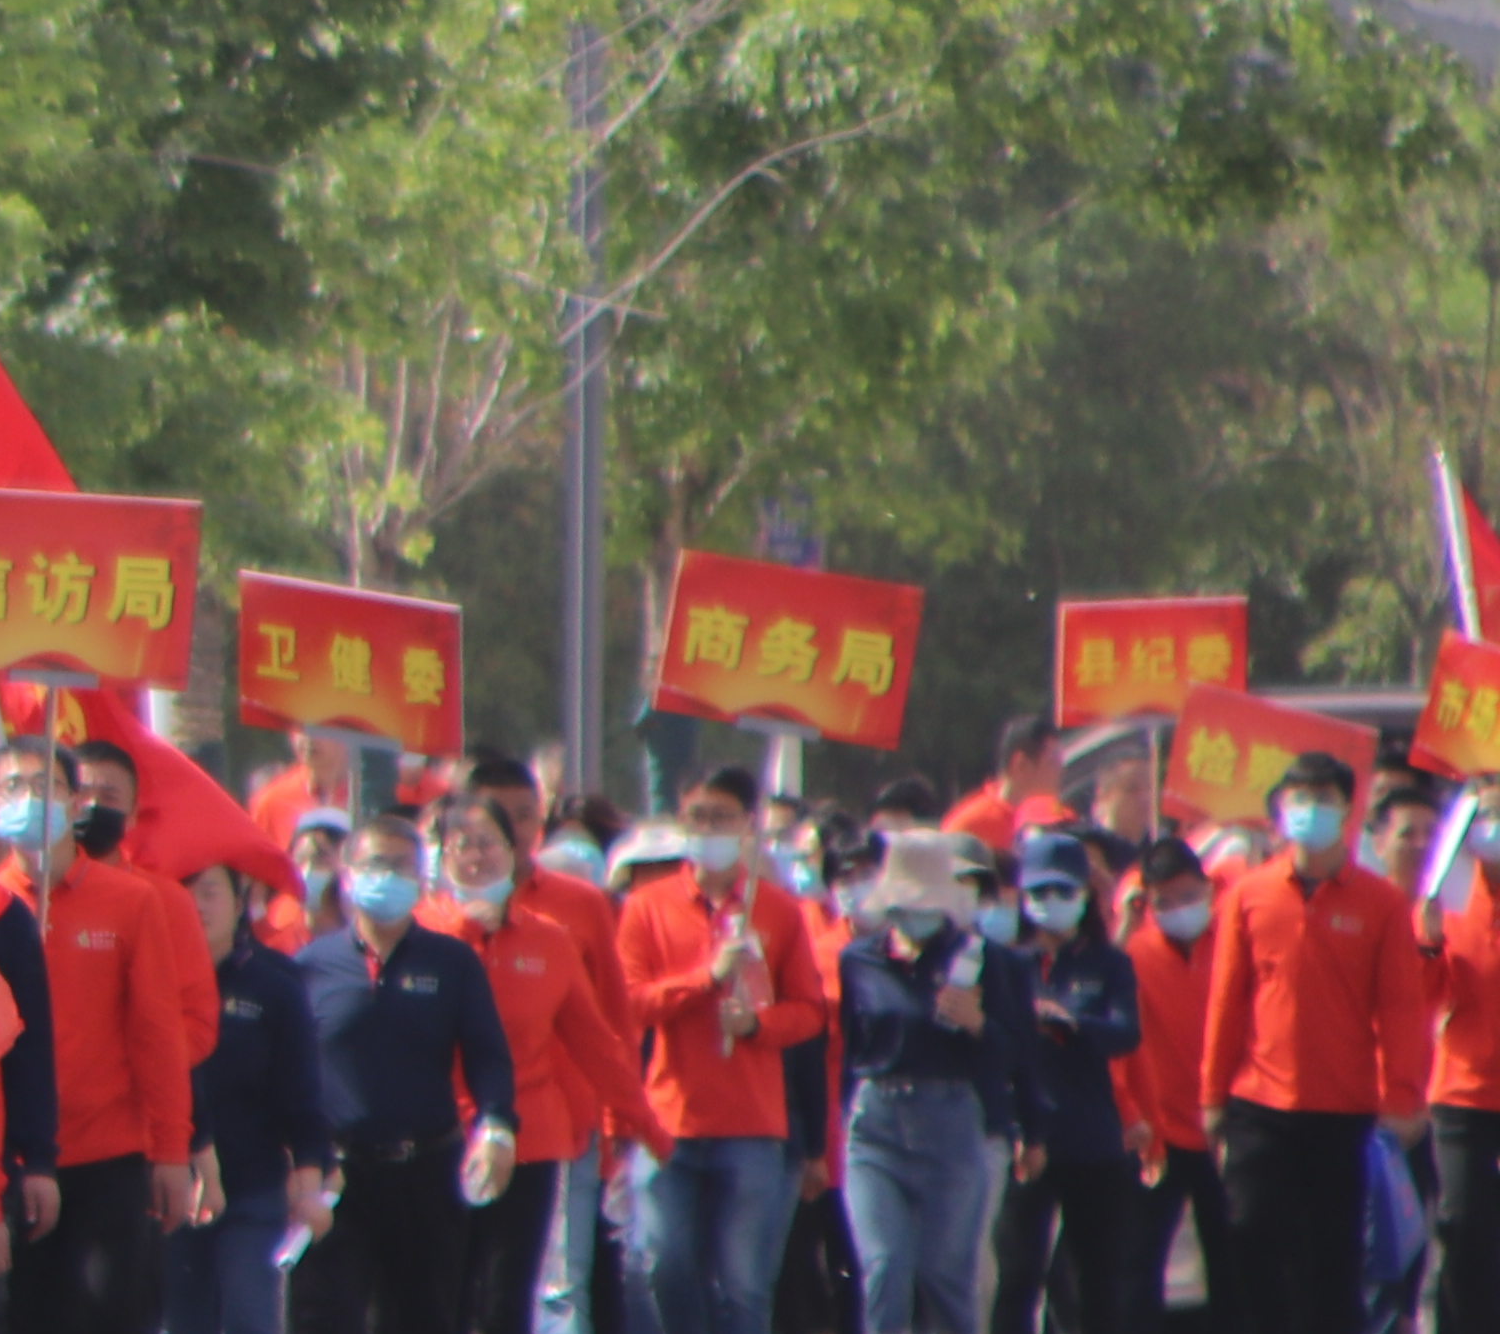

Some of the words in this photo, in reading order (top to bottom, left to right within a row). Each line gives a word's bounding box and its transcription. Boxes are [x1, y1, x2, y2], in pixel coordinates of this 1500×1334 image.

[256, 623, 446, 707] 卫健委
[682, 605, 896, 697] 商务局
